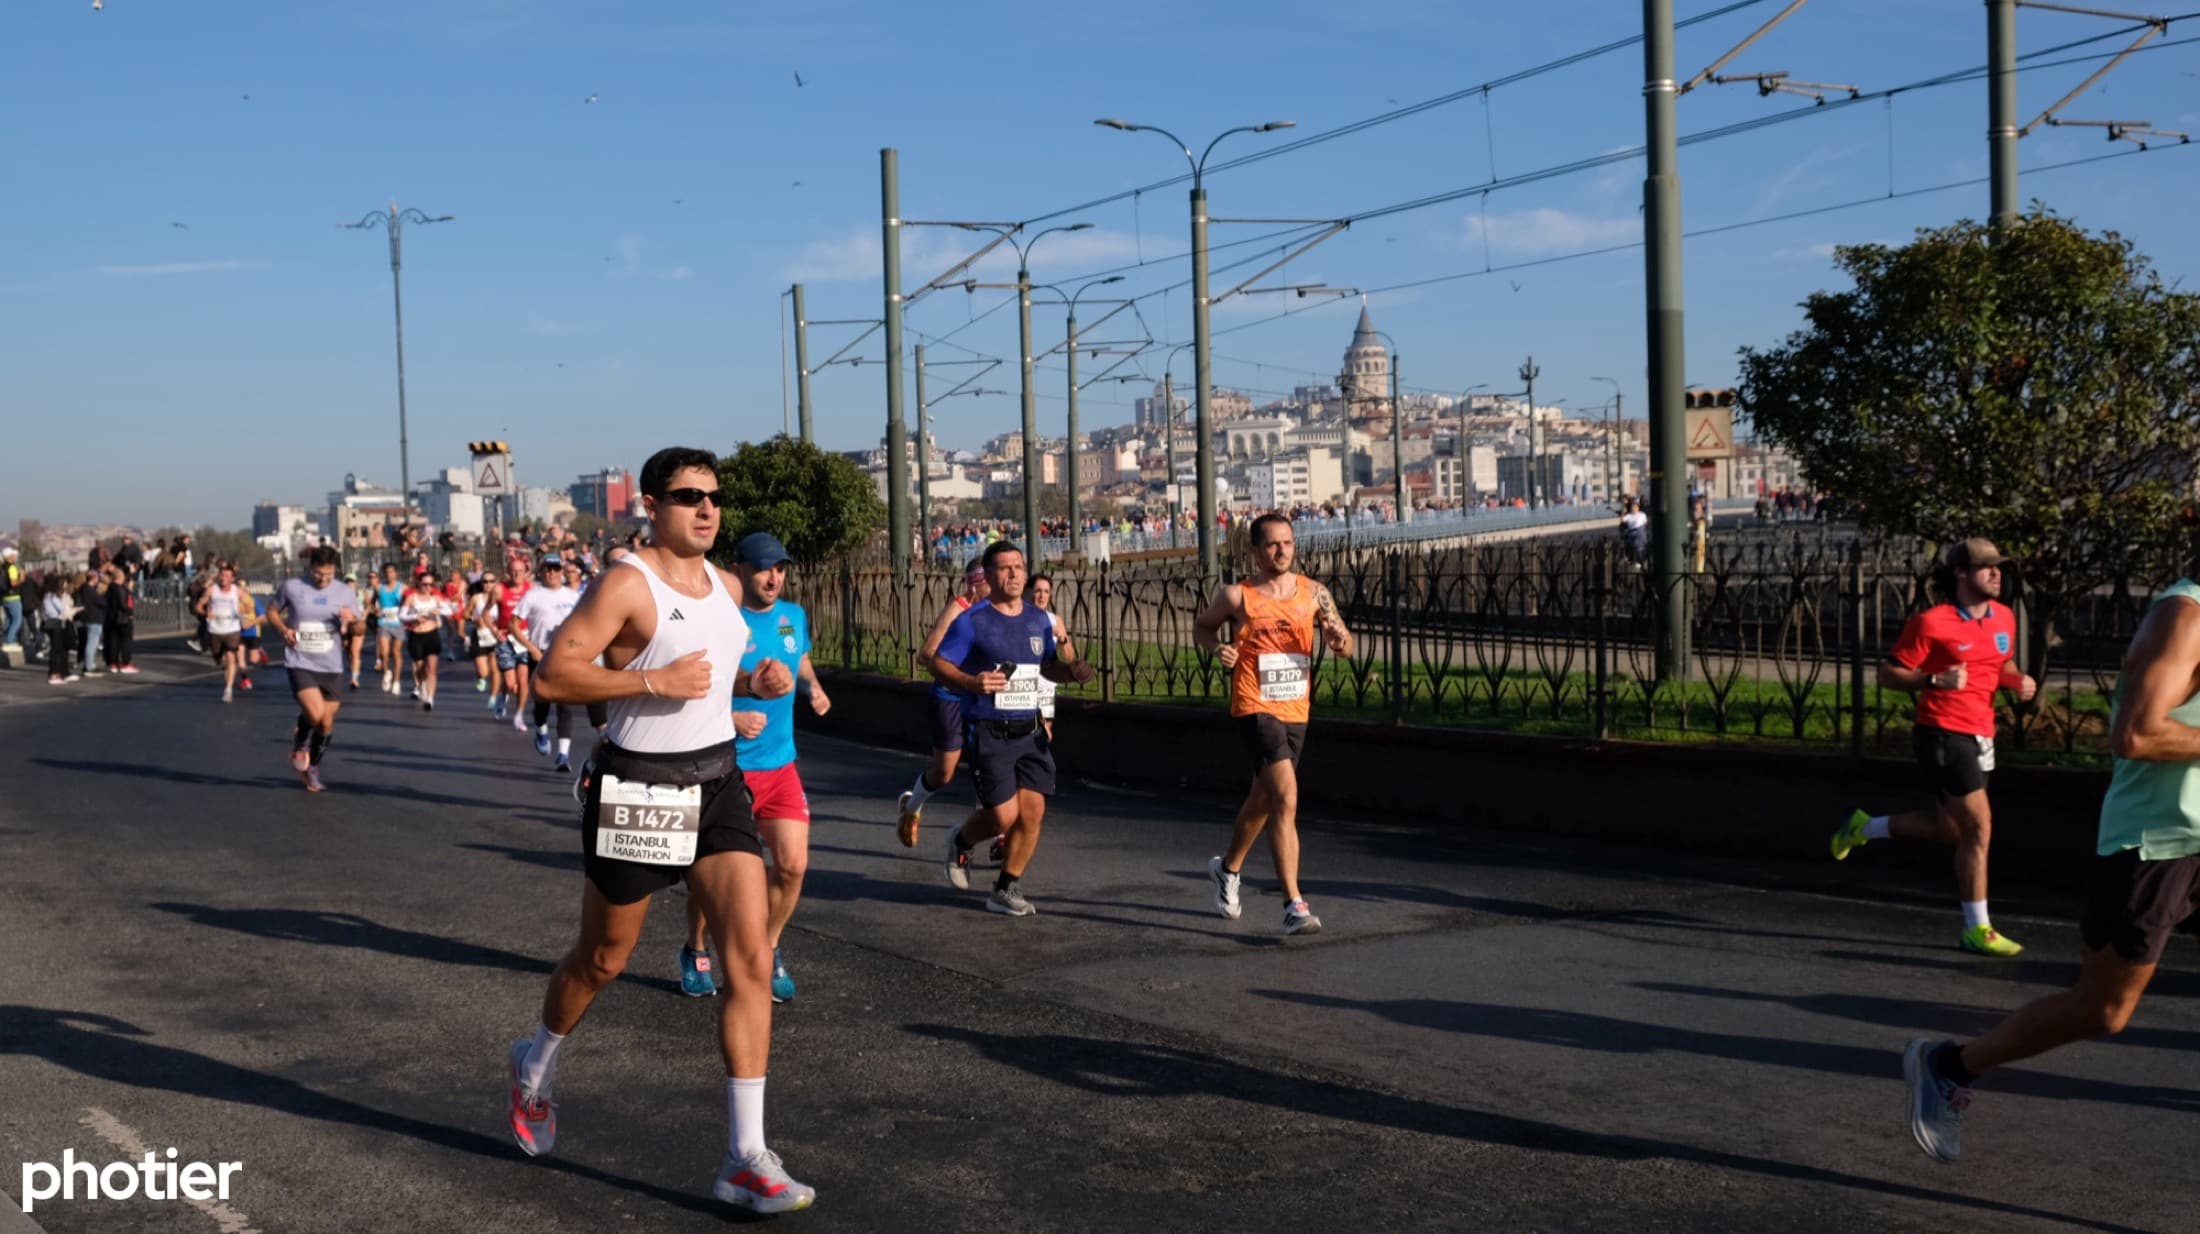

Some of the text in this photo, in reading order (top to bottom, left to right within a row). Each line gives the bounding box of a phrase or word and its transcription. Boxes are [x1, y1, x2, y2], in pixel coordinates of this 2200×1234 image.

[1268, 669, 1302, 682] B 2179
[1013, 681, 1035, 691] 1906
[614, 805, 685, 830] B 1472
[614, 832, 671, 849] ISTANBUL
[612, 846, 671, 861] MARATHON
